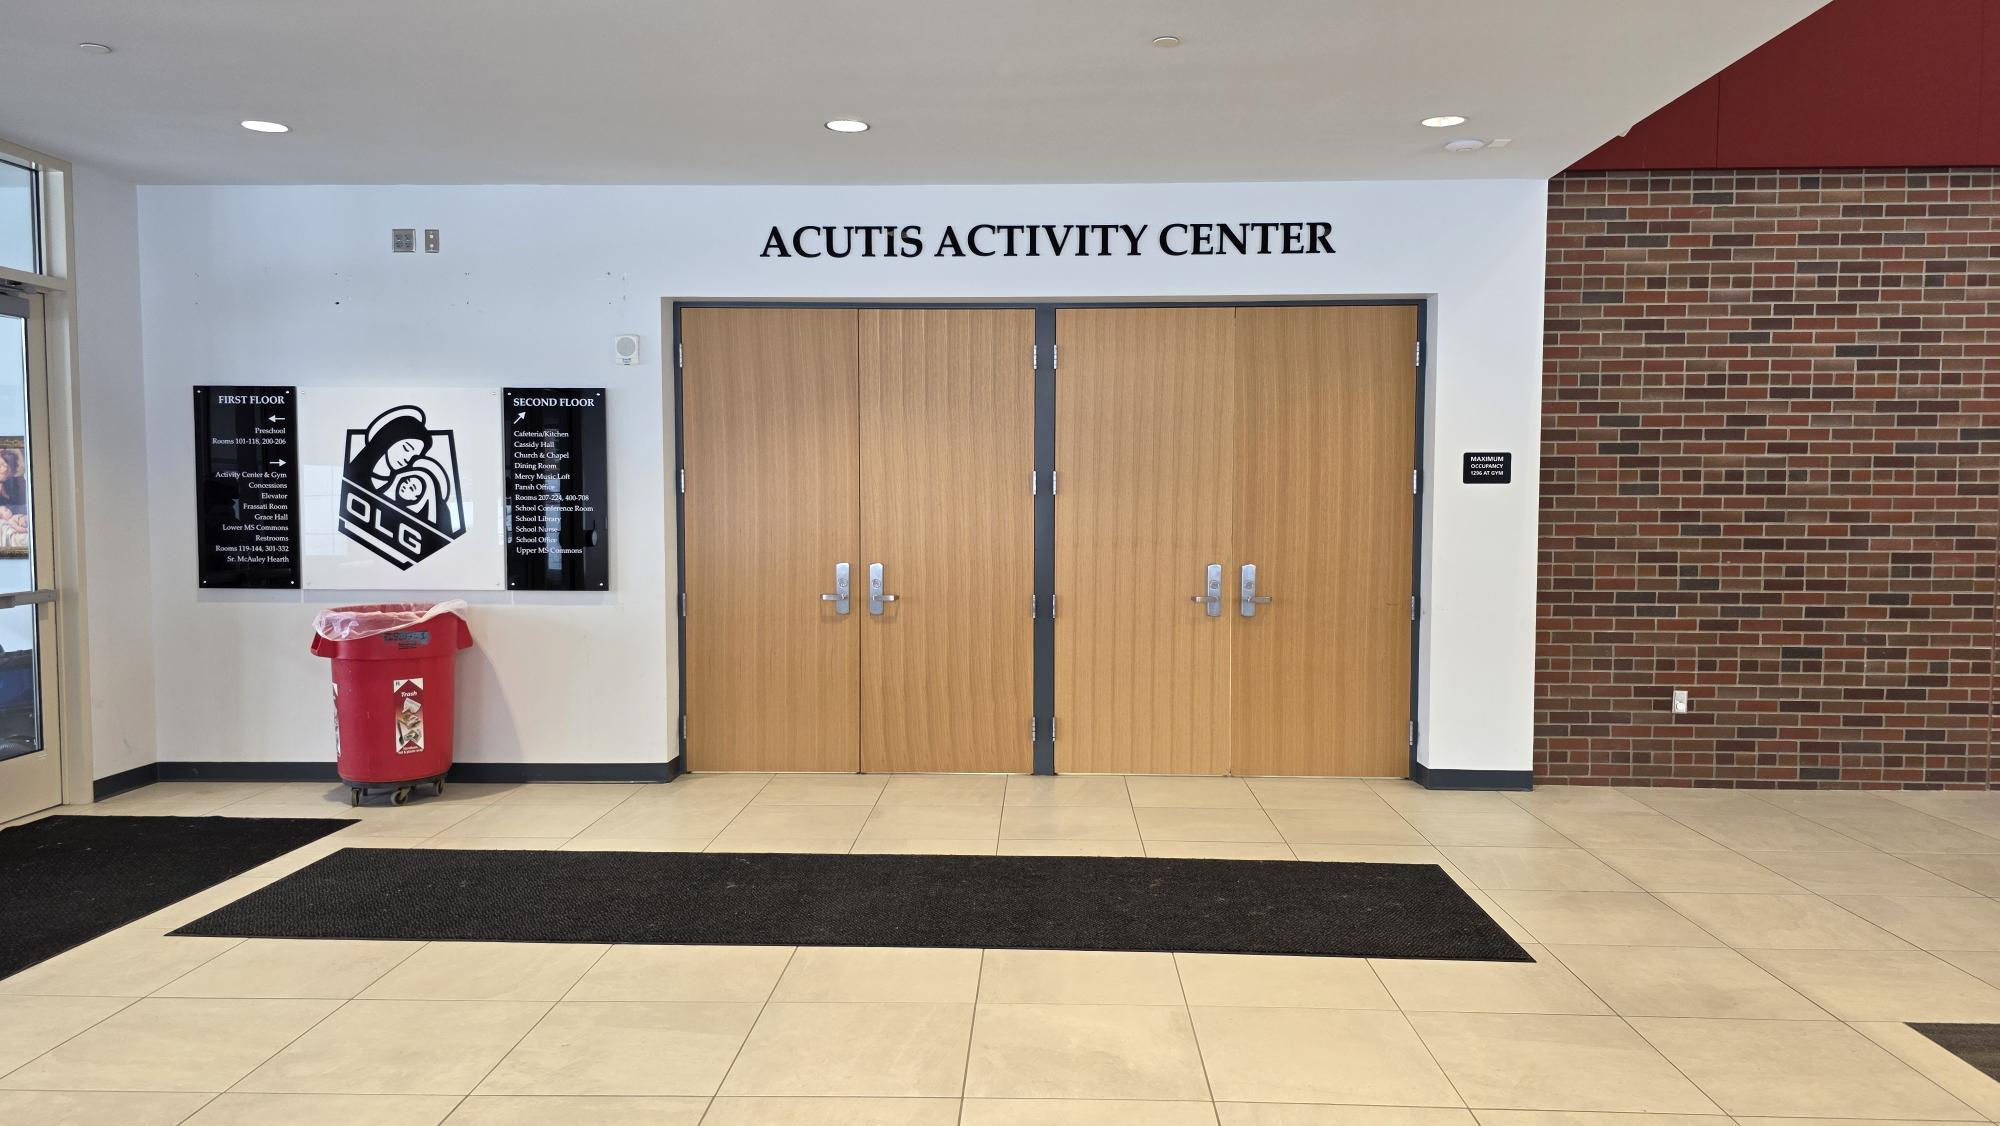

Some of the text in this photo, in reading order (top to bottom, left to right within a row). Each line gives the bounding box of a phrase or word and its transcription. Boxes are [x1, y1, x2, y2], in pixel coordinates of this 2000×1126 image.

[759, 222, 1337, 258] ACUTIS ACTIVITY CENTER
[218, 395, 285, 404] FIRST FLOOR
[513, 398, 595, 407] SECOND FLOOR
[513, 430, 569, 438] Cafeteria/Kitchen
[212, 437, 235, 445] Rooms
[235, 438, 261, 446] 101-118,
[513, 441, 539, 449] Cassidy
[513, 451, 539, 459] Church
[546, 451, 570, 460] Chapel
[514, 462, 537, 471] Dining
[215, 471, 241, 480] Activity
[270, 472, 287, 480] Gym
[514, 473, 535, 481] Mercy
[248, 481, 288, 489] Concessions
[514, 483, 535, 491] Parish
[538, 494, 564, 502] 207-224,
[254, 513, 274, 521] Grace
[538, 515, 562, 523] Library
[222, 523, 243, 531] Lower
[347, 492, 422, 555] OLG
[515, 525, 537, 533] School
[238, 545, 264, 553] 119-144,
[516, 546, 537, 555] Upper
[237, 555, 266, 564] McAuley
[400, 690, 418, 698] Trash
